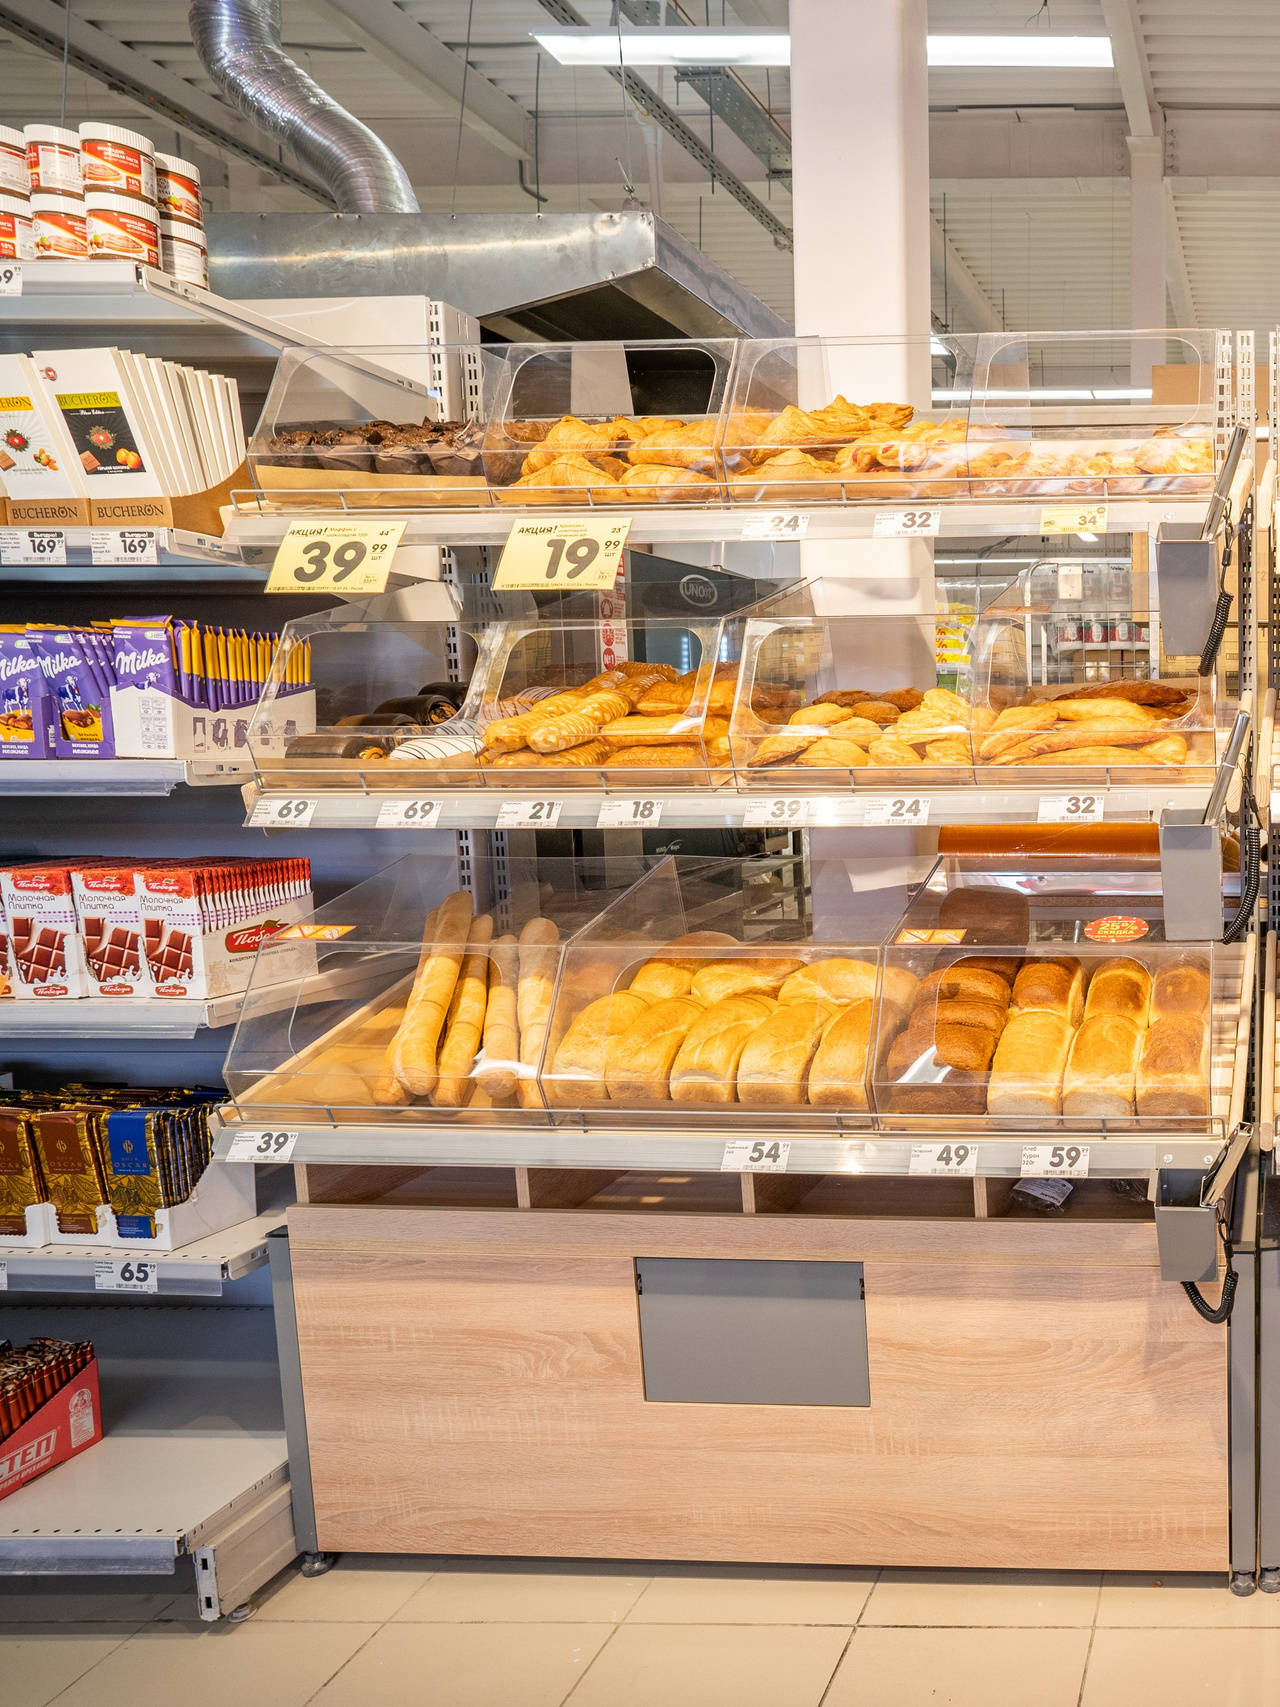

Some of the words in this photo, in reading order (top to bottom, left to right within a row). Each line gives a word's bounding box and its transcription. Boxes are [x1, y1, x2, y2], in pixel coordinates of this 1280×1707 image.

[770, 515, 800, 532] 24
[902, 512, 932, 528] 32
[1078, 516, 1098, 526] 34
[288, 528, 328, 536] АКЦИЯ!
[518, 526, 558, 535] АКЦИЯ!
[30, 539, 56, 554] 169
[122, 539, 147, 554] 169
[372, 544, 388, 552] 99
[604, 540, 620, 550] 99
[294, 541, 367, 582] 39
[546, 538, 600, 579] 19
[37, 652, 82, 678] Milka
[116, 648, 170, 674] Milka
[278, 800, 308, 818] 69
[404, 801, 434, 820] 69
[528, 802, 554, 820] 21
[632, 800, 654, 818] 18
[770, 800, 800, 818] 39
[890, 800, 920, 816] 24
[1066, 796, 1095, 814] 32
[16, 880, 50, 888] Победа
[88, 881, 122, 889] Победа
[148, 882, 180, 890] Победа
[8, 894, 56, 902] Молочная
[140, 895, 184, 904] Молочная
[1100, 922, 1138, 930] 25%
[256, 1132, 289, 1154] 39
[749, 1142, 780, 1163] 54
[936, 1145, 969, 1166] 49
[1050, 1146, 1081, 1168] 59
[120, 1262, 149, 1282] 65
